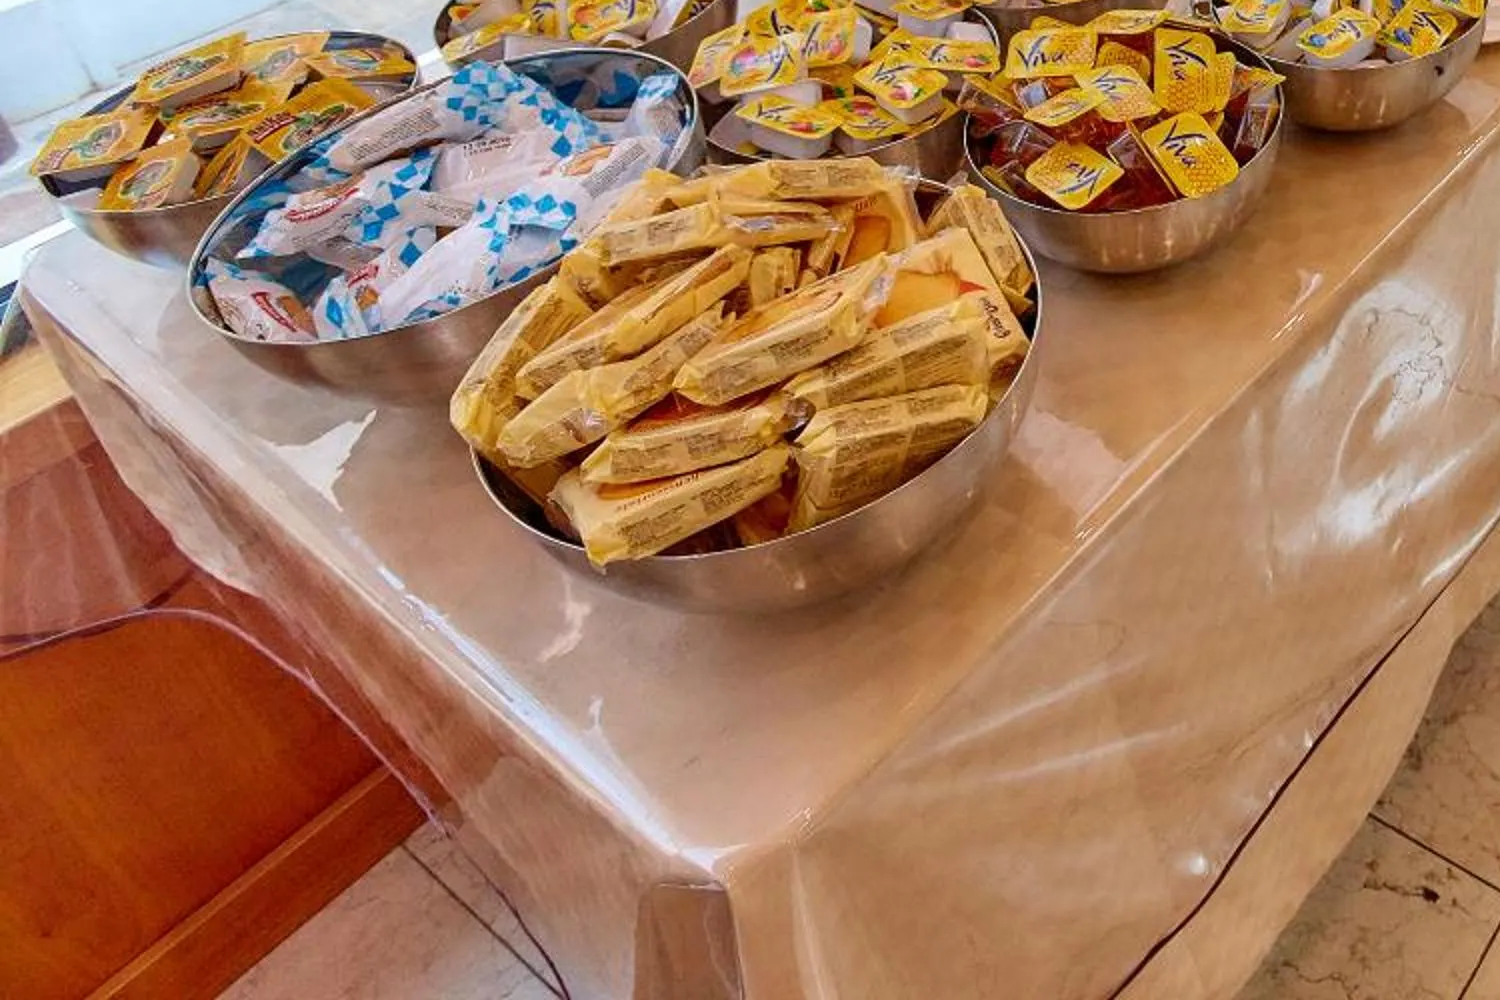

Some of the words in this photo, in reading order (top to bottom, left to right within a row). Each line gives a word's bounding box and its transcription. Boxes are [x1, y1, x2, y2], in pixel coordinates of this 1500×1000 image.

[1017, 34, 1066, 70] Viva
[1165, 37, 1208, 82] Viva
[1159, 120, 1207, 168] Viva
